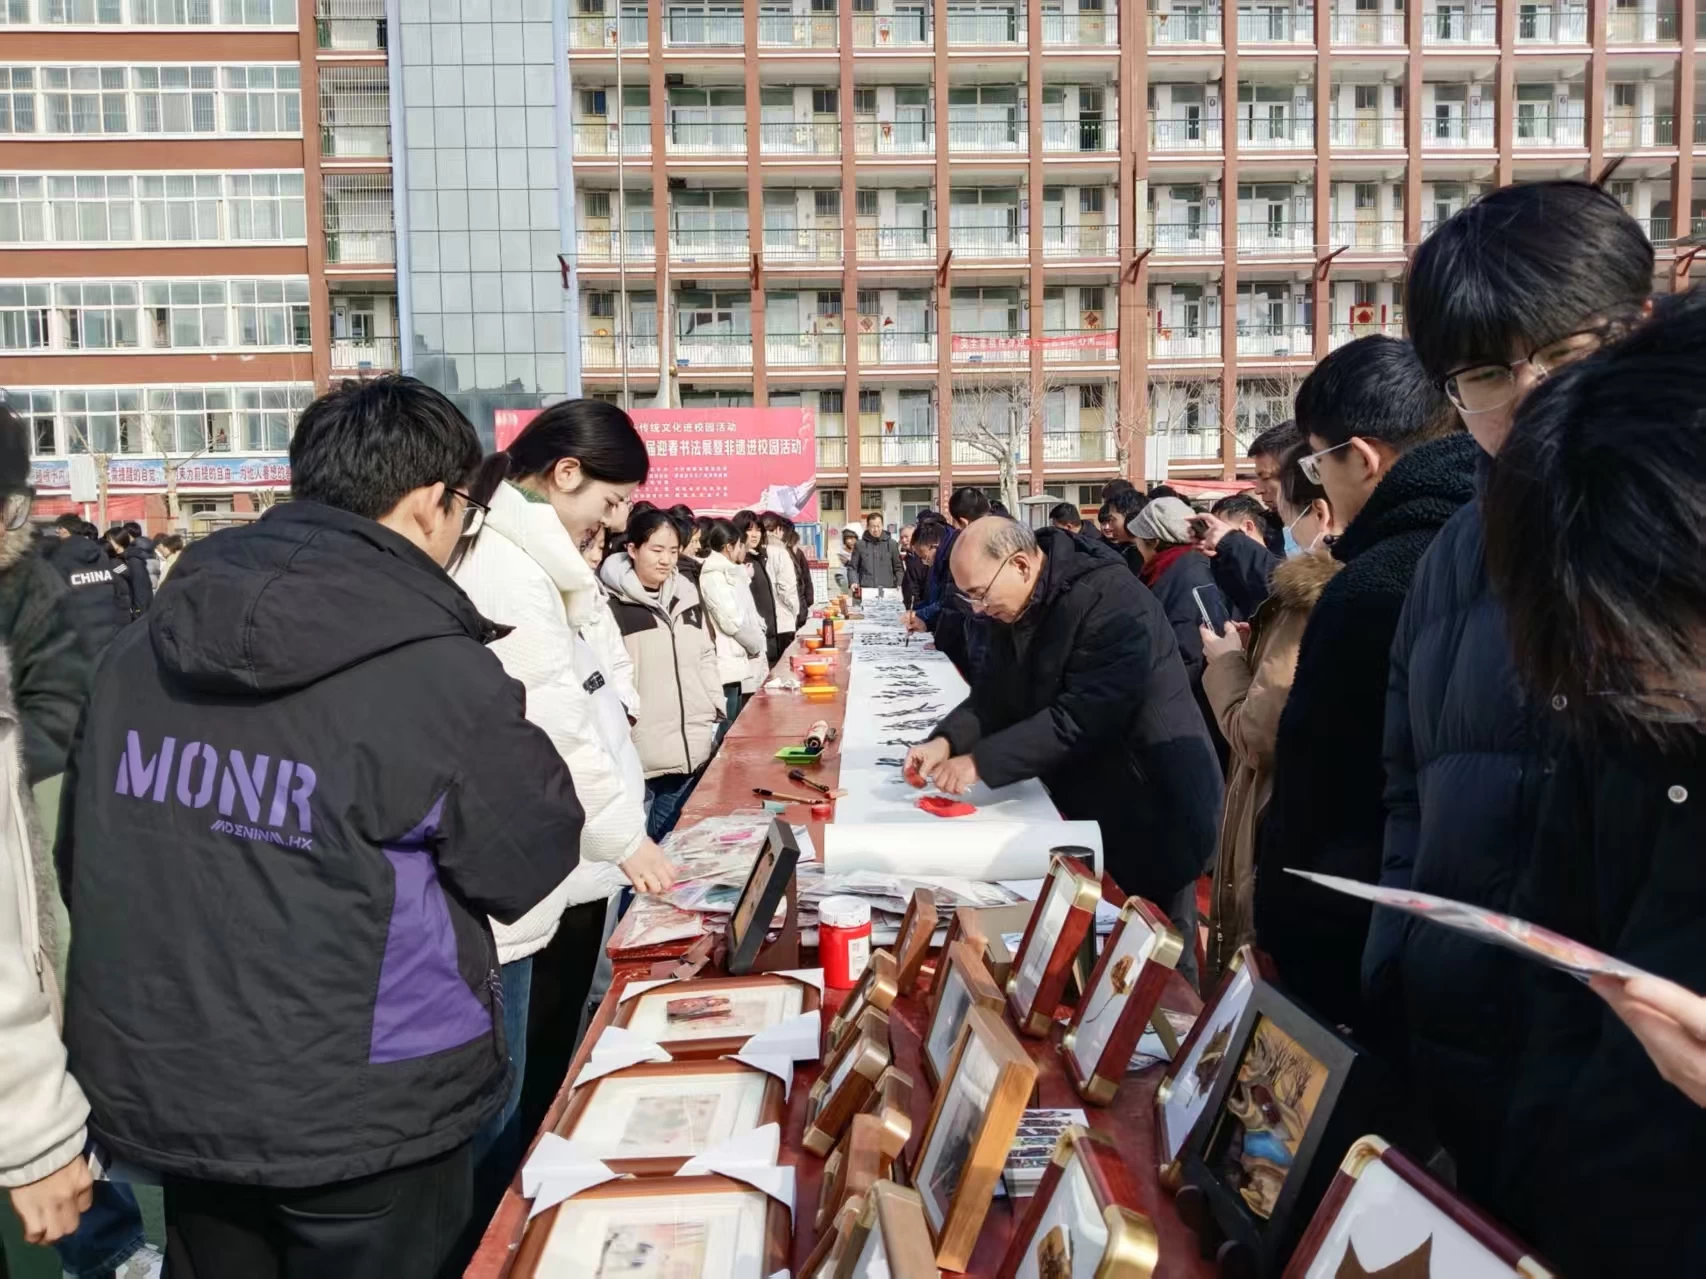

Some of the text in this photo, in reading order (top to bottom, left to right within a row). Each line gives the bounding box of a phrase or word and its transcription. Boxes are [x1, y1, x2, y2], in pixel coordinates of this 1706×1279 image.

[634, 421, 736, 433] 传统文化进校园活动
[70, 569, 113, 586] CHINA
[115, 729, 317, 834] MONR
